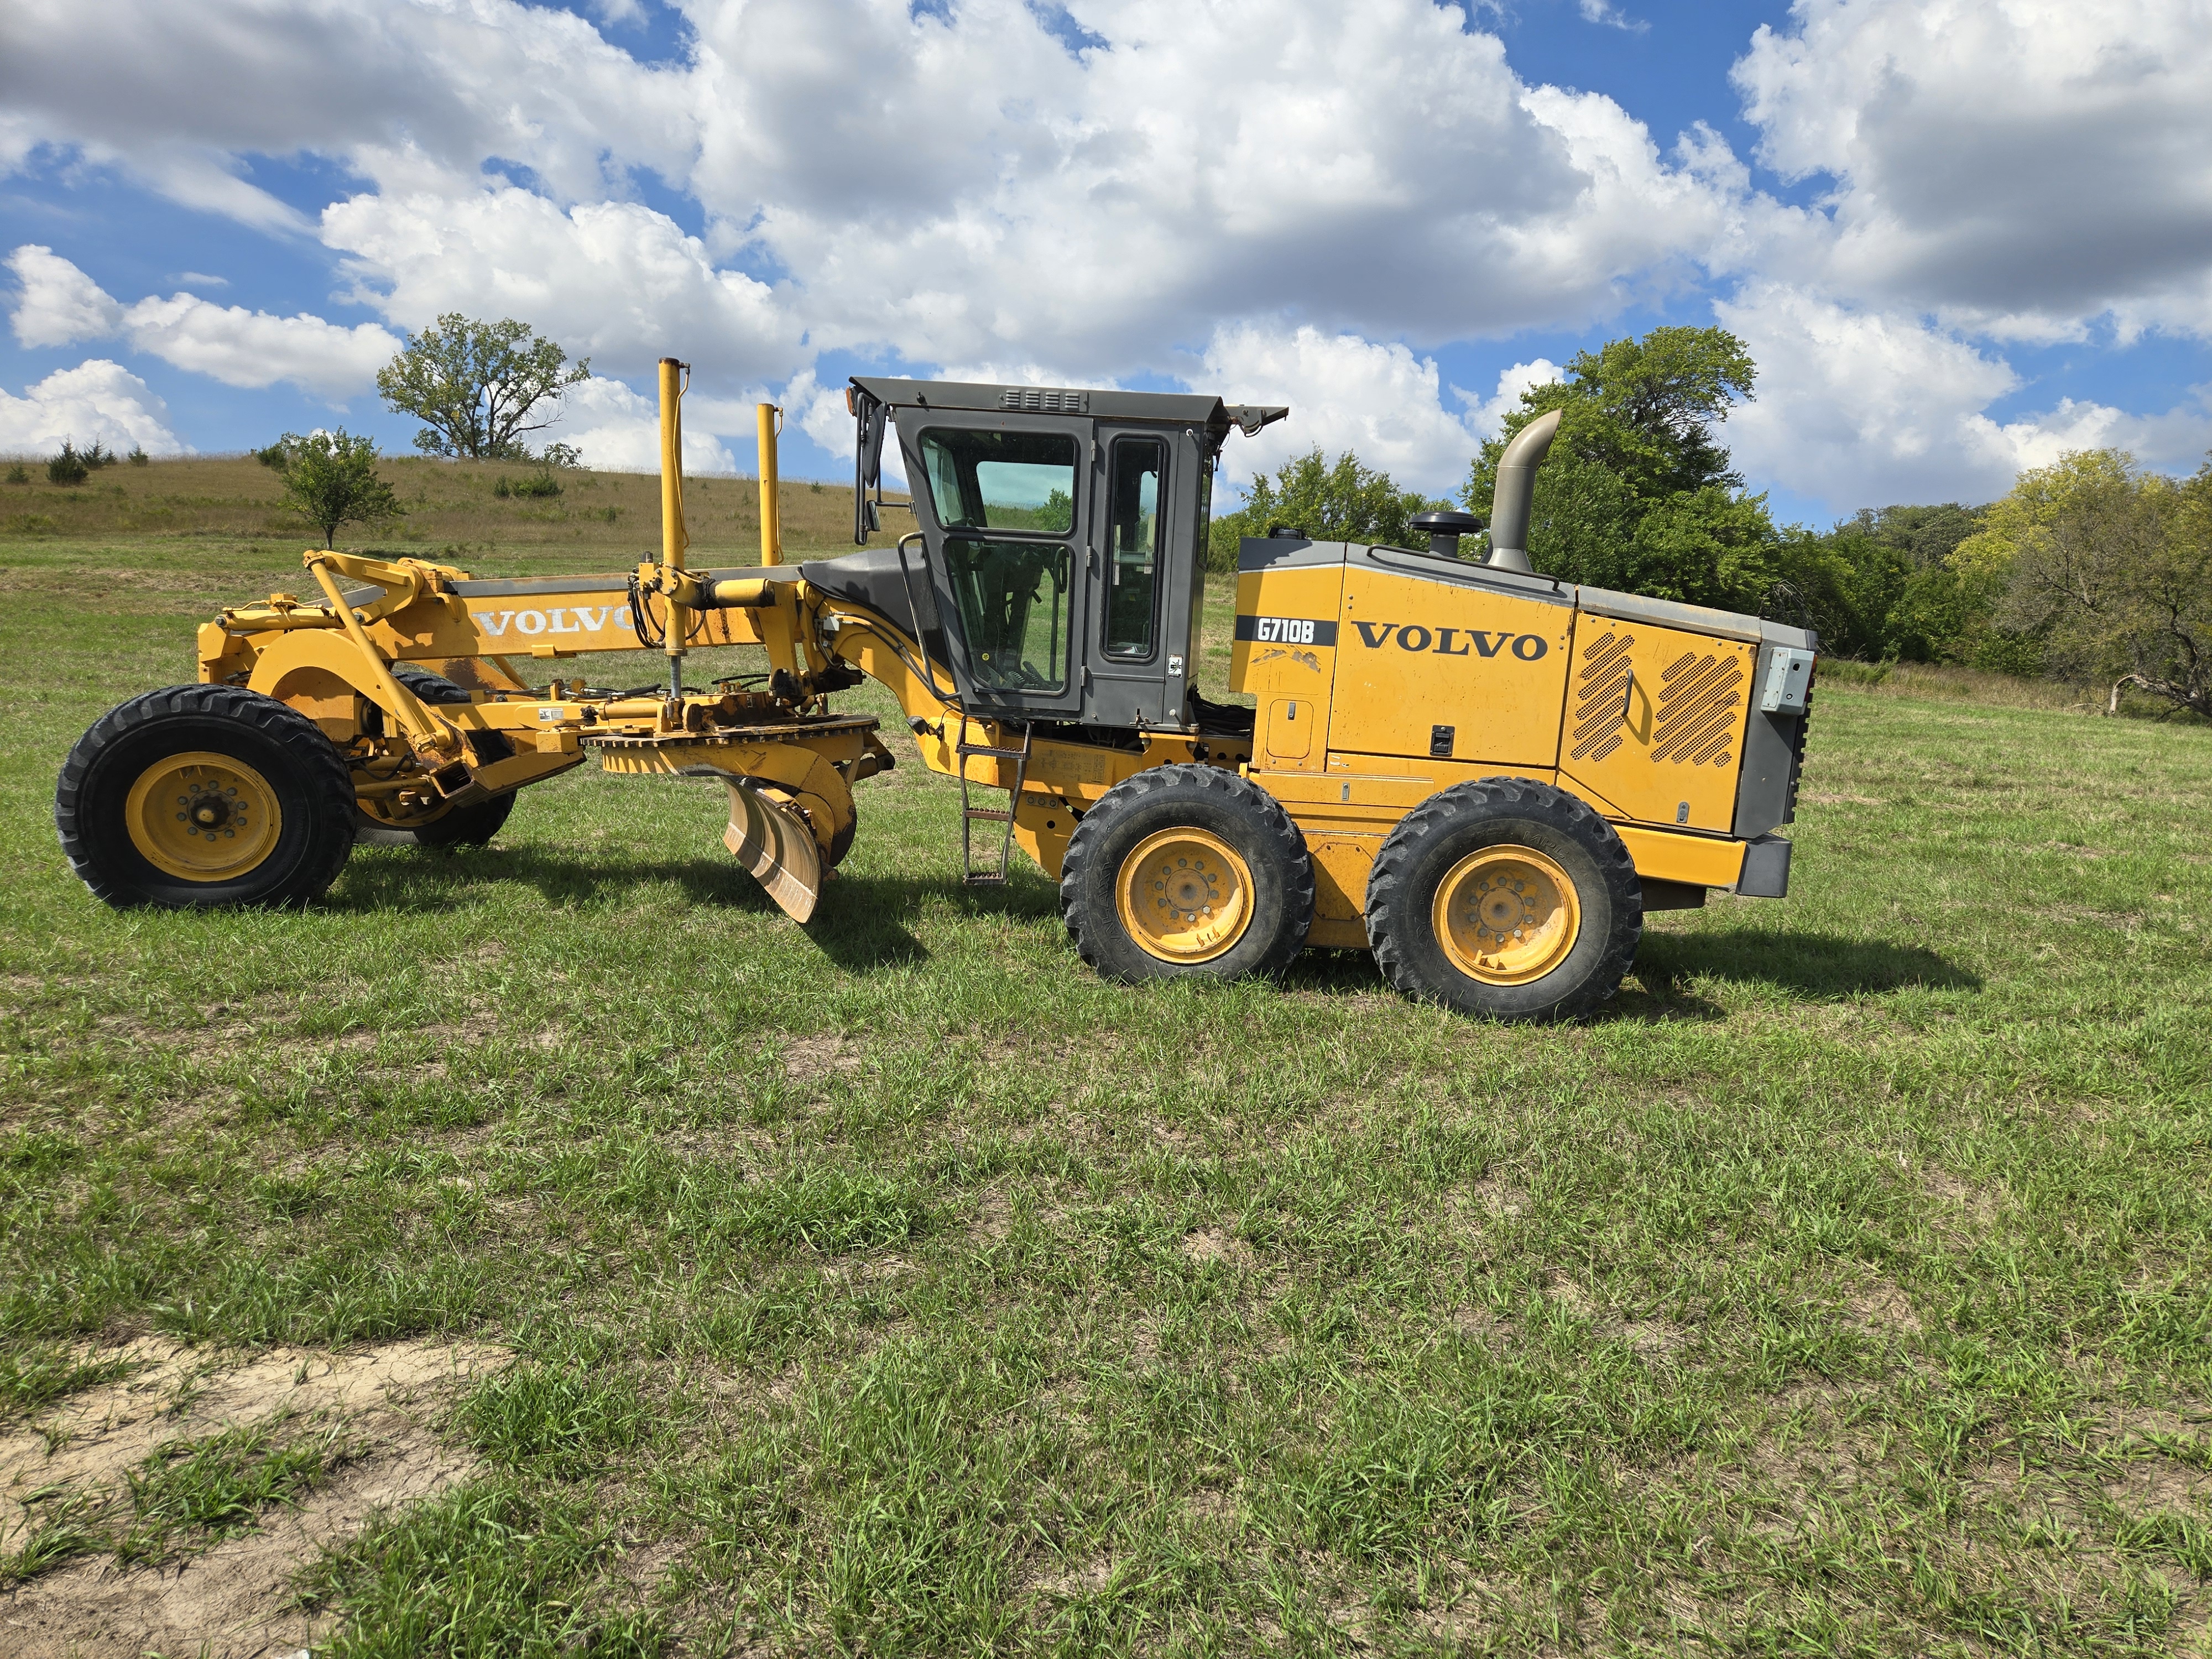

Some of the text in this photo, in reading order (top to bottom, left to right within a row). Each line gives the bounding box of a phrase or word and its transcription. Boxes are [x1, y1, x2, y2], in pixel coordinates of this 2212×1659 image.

[472, 604, 645, 636] VOLVO
[1258, 618, 1314, 643] G710B
[1350, 620, 1548, 661] VOLVO
[1097, 854, 1129, 955] GALAXY
